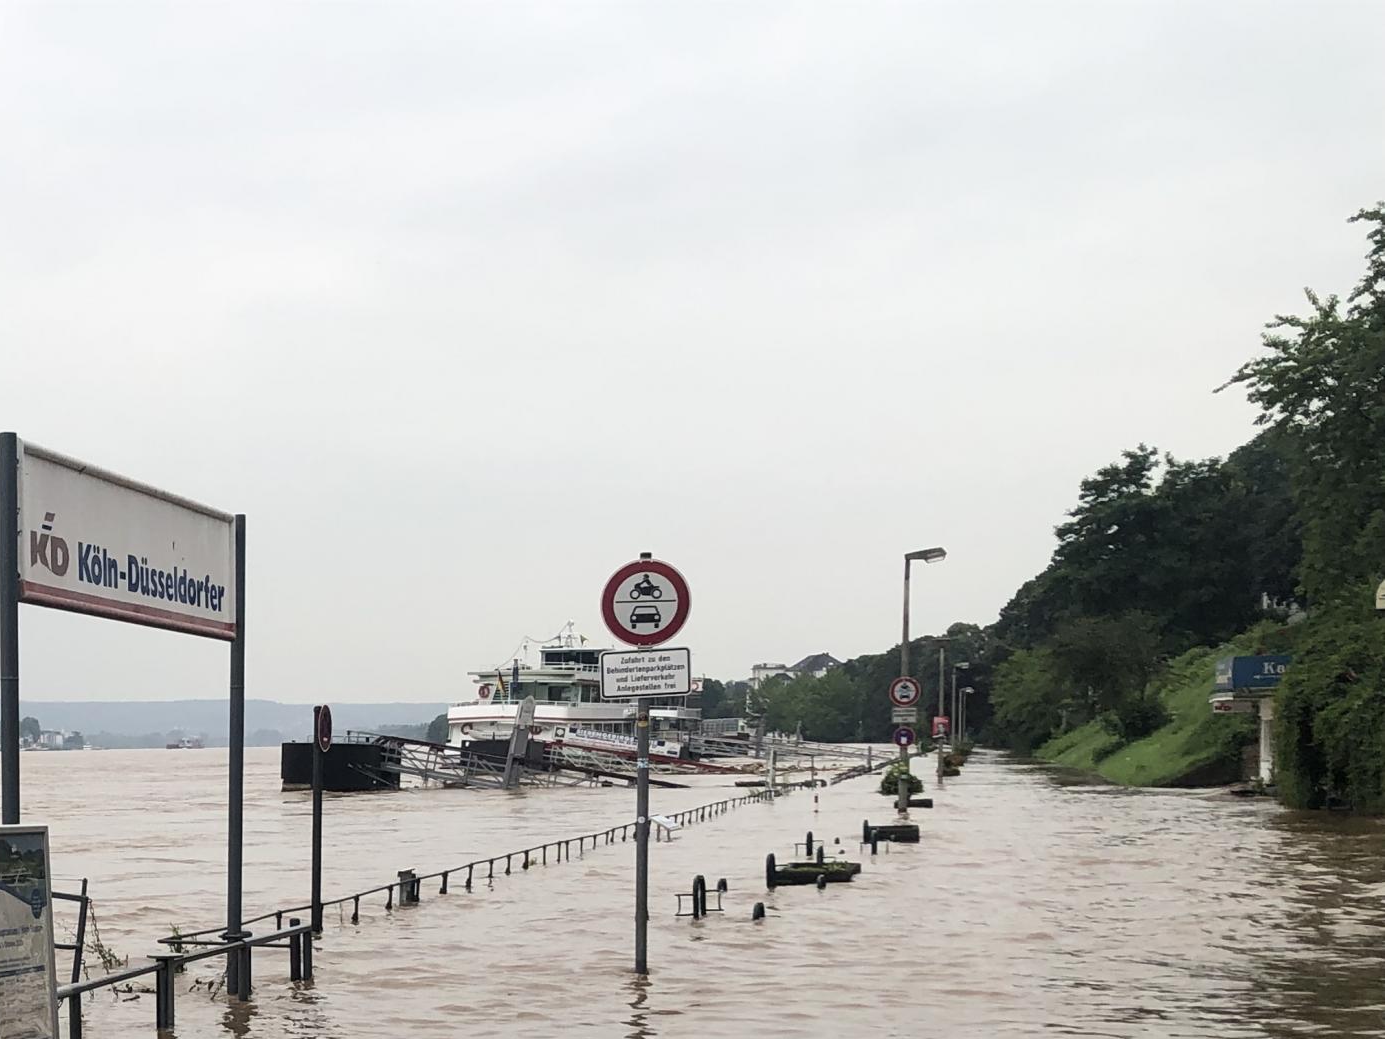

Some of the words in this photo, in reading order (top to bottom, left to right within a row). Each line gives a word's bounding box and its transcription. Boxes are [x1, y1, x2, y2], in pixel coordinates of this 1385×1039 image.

[30, 530, 70, 577] KD
[77, 541, 225, 612] Köln-Düsseldorfer
[620, 655, 645, 665] Zufahrt
[658, 654, 671, 662] den
[606, 663, 685, 675] Behindertenparkplätzen
[616, 675, 628, 683] und
[630, 673, 676, 682] Lieferverkehr
[616, 682, 661, 692] Anlegestellen
[664, 682, 677, 690] frei
